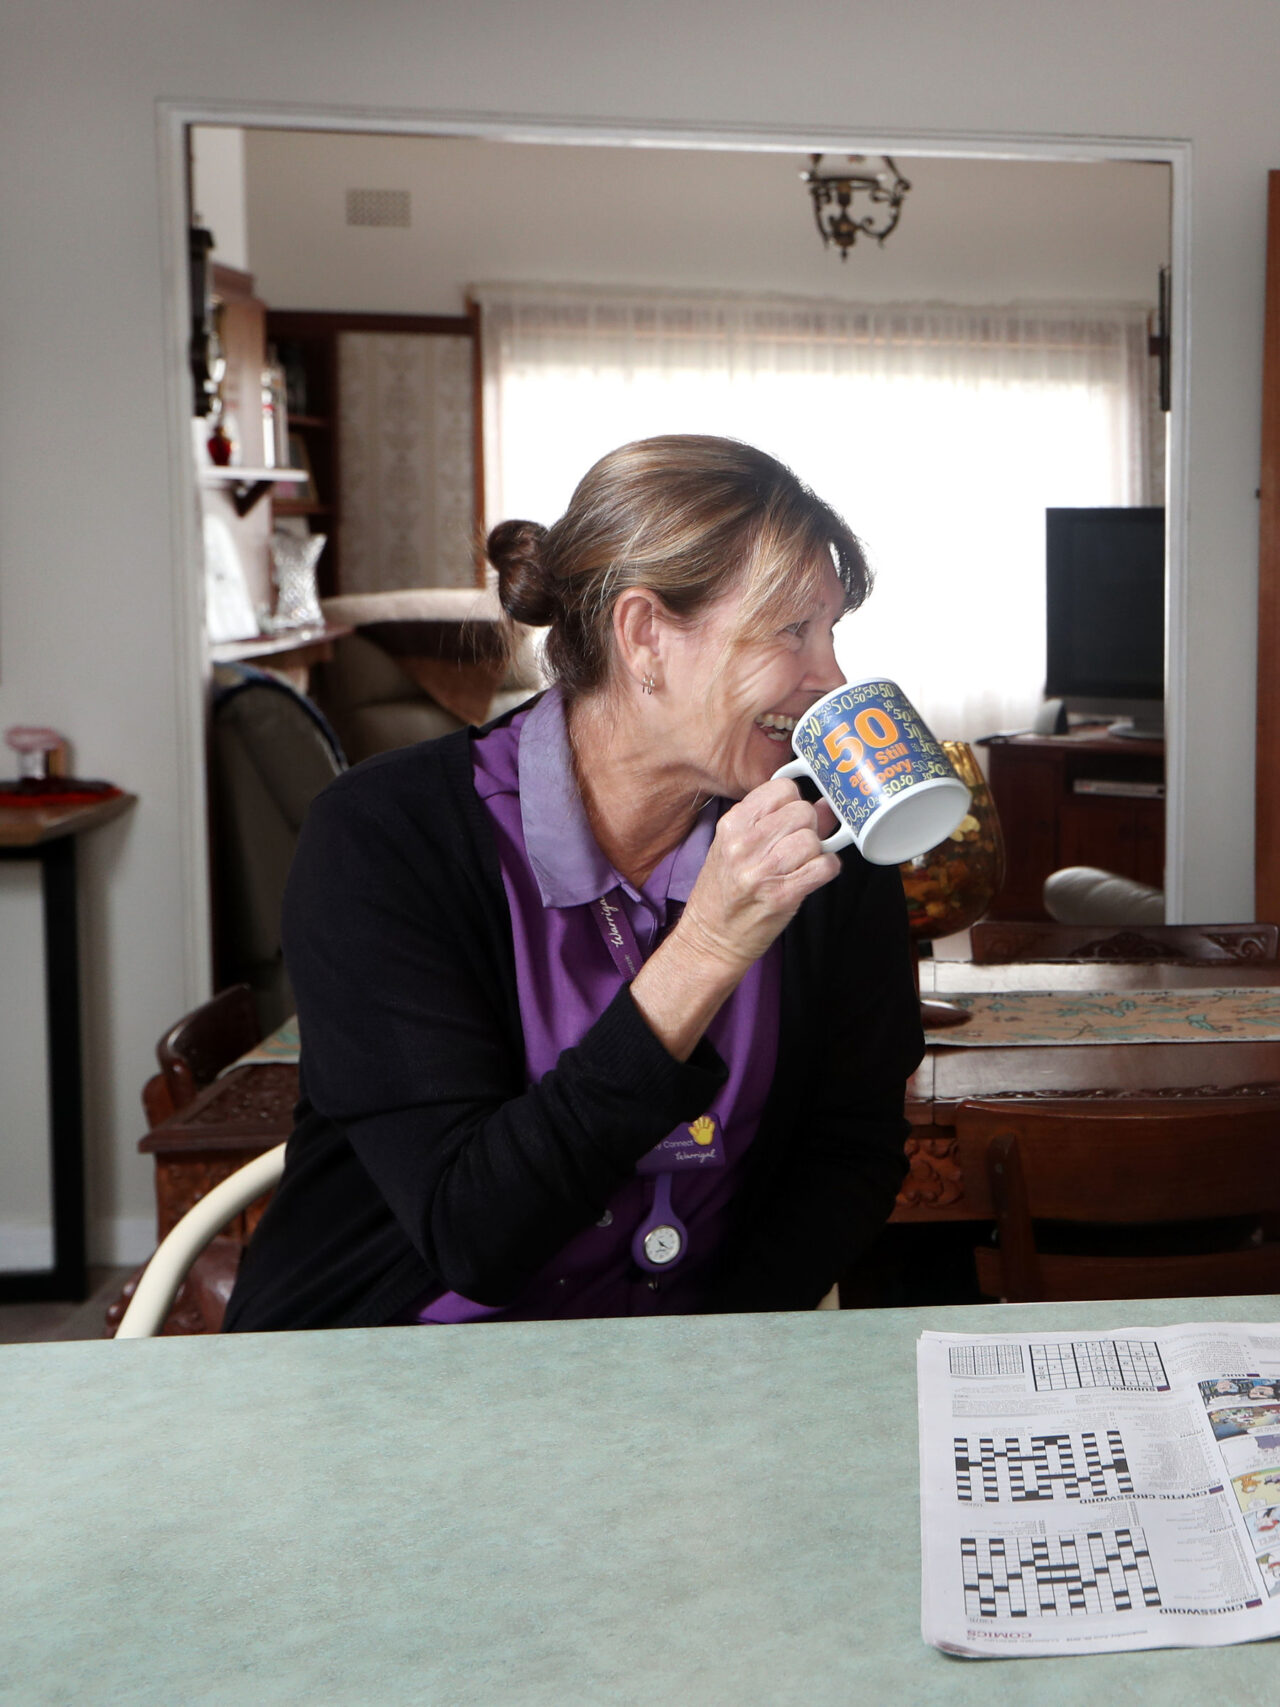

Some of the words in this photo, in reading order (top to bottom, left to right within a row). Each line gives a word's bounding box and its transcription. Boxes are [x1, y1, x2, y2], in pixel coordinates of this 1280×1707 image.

[853, 692, 866, 704] 50
[863, 684, 879, 698] 50
[831, 695, 854, 715] 50
[804, 716, 821, 743] 50
[823, 707, 899, 774] 50
[874, 743, 909, 765] Still
[927, 761, 946, 776] 50
[859, 758, 912, 796] Goovy
[900, 775, 914, 787] 50
[882, 780, 901, 797] 50
[600, 896, 624, 948] Warriga
[1079, 1493, 1157, 1504] CROSSWORD
[1159, 1490, 1208, 1500] CRYPTIC
[1159, 1604, 1244, 1616] CROSSWORD
[966, 1629, 1033, 1640] COMICS
